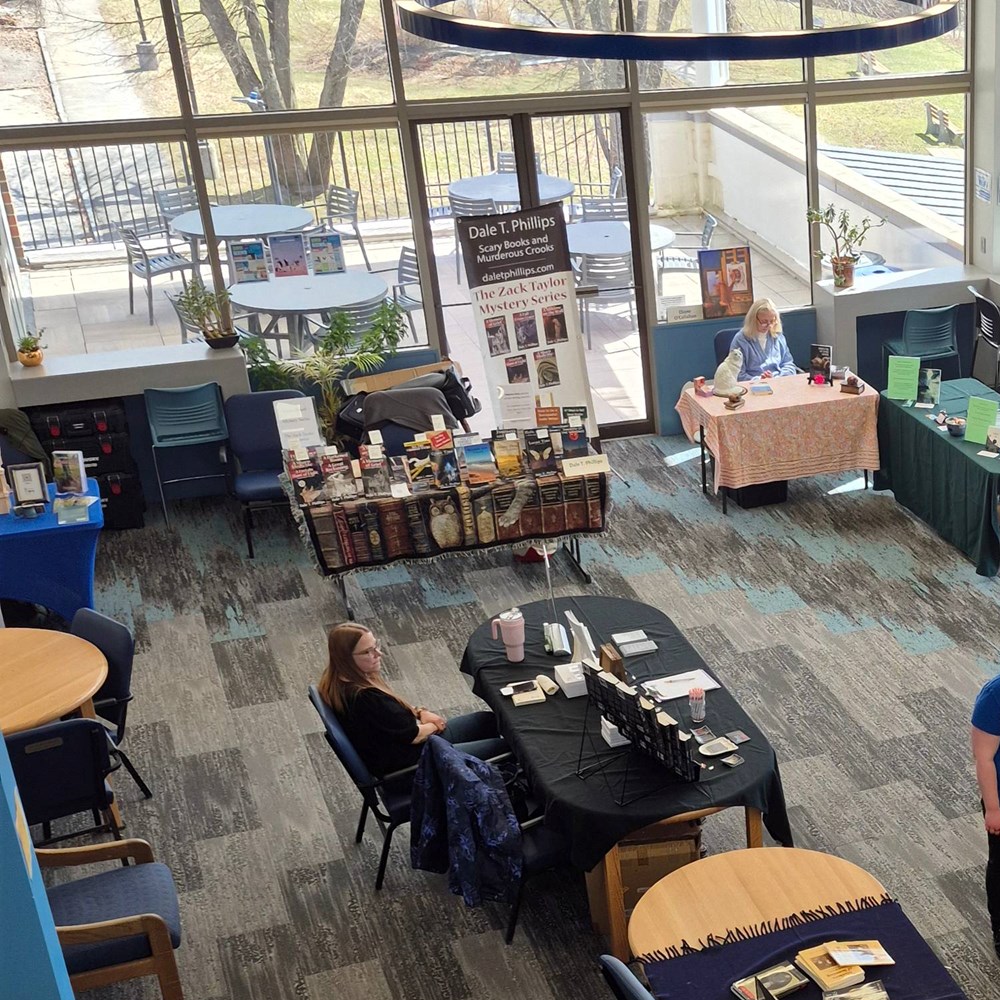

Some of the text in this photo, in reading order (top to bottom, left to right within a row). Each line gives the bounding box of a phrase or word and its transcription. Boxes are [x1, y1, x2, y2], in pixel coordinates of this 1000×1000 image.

[468, 216, 556, 240] Dale T. Phillips
[477, 244, 554, 264] Murderous Crooks
[478, 234, 548, 254] Scary Books and
[482, 263, 554, 282] daletphillips.com
[474, 277, 568, 302] The Zack Taylor
[480, 298, 528, 315] Mystery
[532, 292, 568, 304] Series
